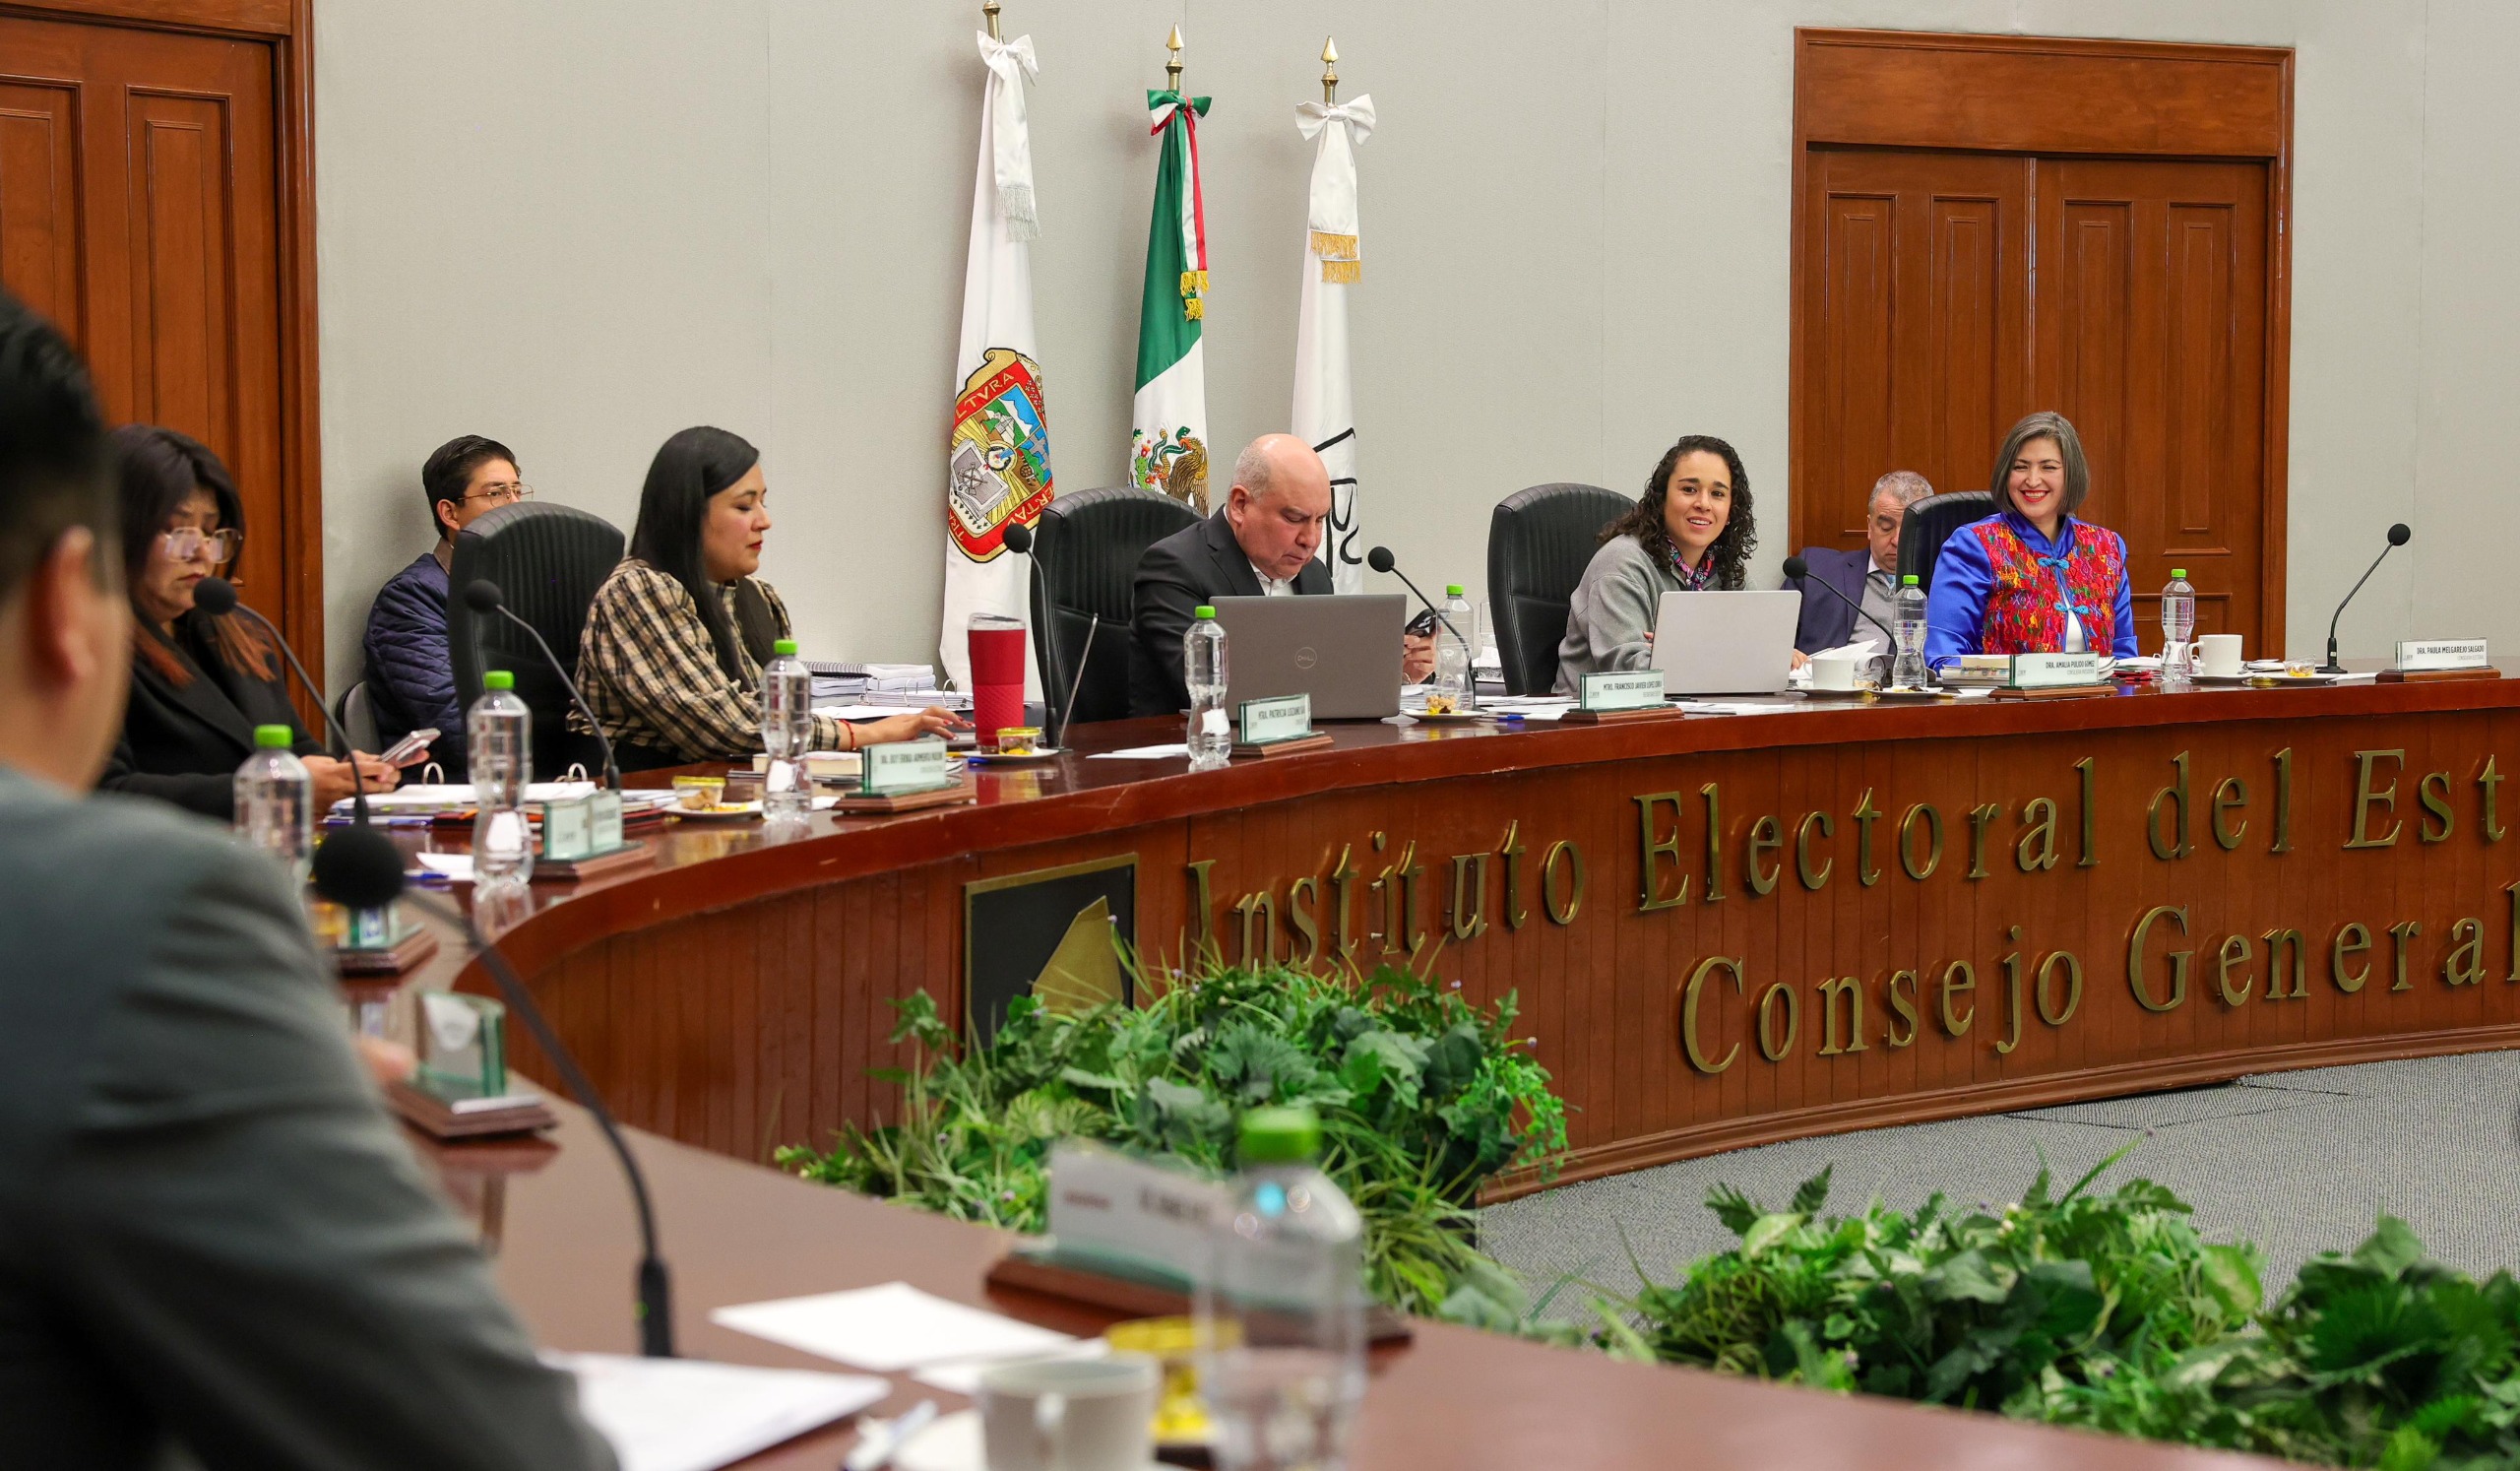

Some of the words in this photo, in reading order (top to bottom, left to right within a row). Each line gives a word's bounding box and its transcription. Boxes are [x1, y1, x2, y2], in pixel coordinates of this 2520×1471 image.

[2441, 645, 2468, 654] MELGAREJO
[2468, 644, 2485, 653] SALGADO
[1188, 818, 1584, 972] Instituto
[1632, 756, 2101, 912] Electoral
[2148, 746, 2294, 862] del
[1682, 926, 2082, 1074] Consejo
[2127, 881, 2520, 1012] General
